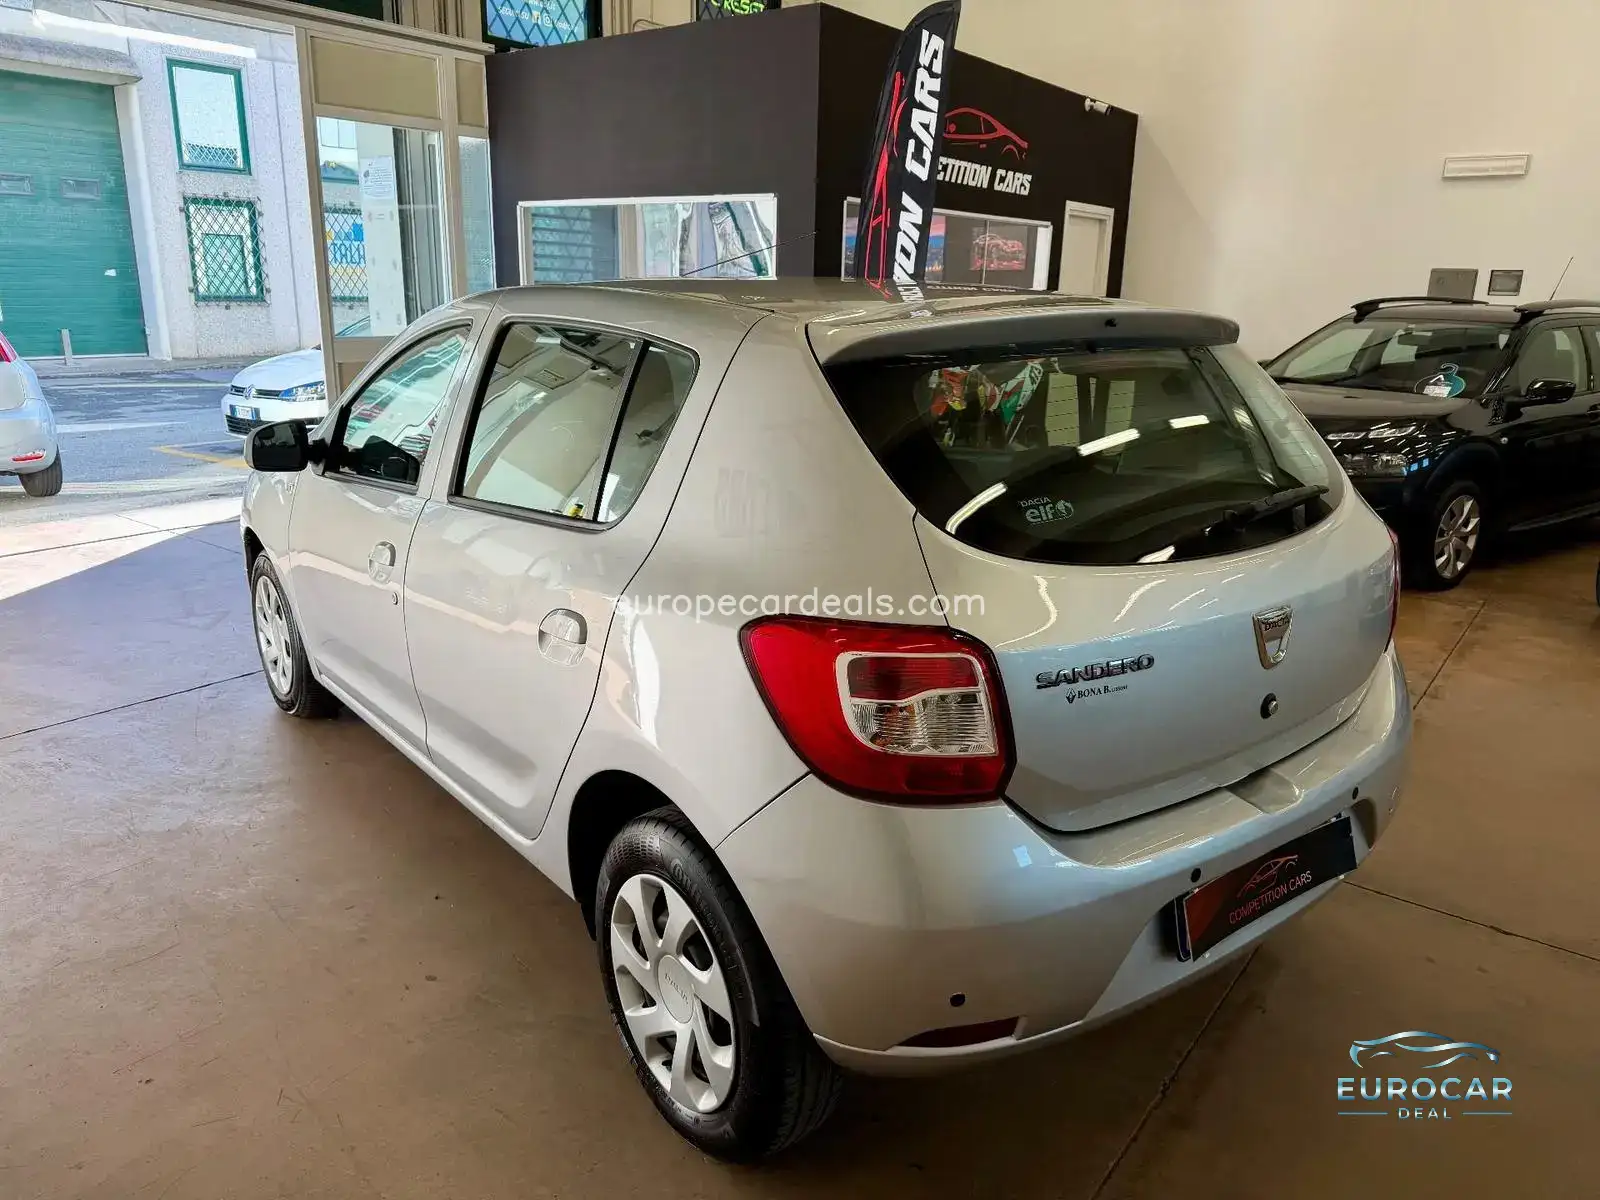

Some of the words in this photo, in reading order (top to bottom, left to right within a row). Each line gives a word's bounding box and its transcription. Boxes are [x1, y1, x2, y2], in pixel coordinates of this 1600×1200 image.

[905, 29, 945, 182] CARS
[993, 168, 1032, 196] CARS
[1020, 496, 1052, 507] DACIA
[1025, 503, 1054, 522] elf
[1036, 653, 1155, 690] SANDERO
[1077, 687, 1102, 699] BONA
[1229, 883, 1288, 925] COMPETITION
[1289, 870, 1313, 891] CARS
